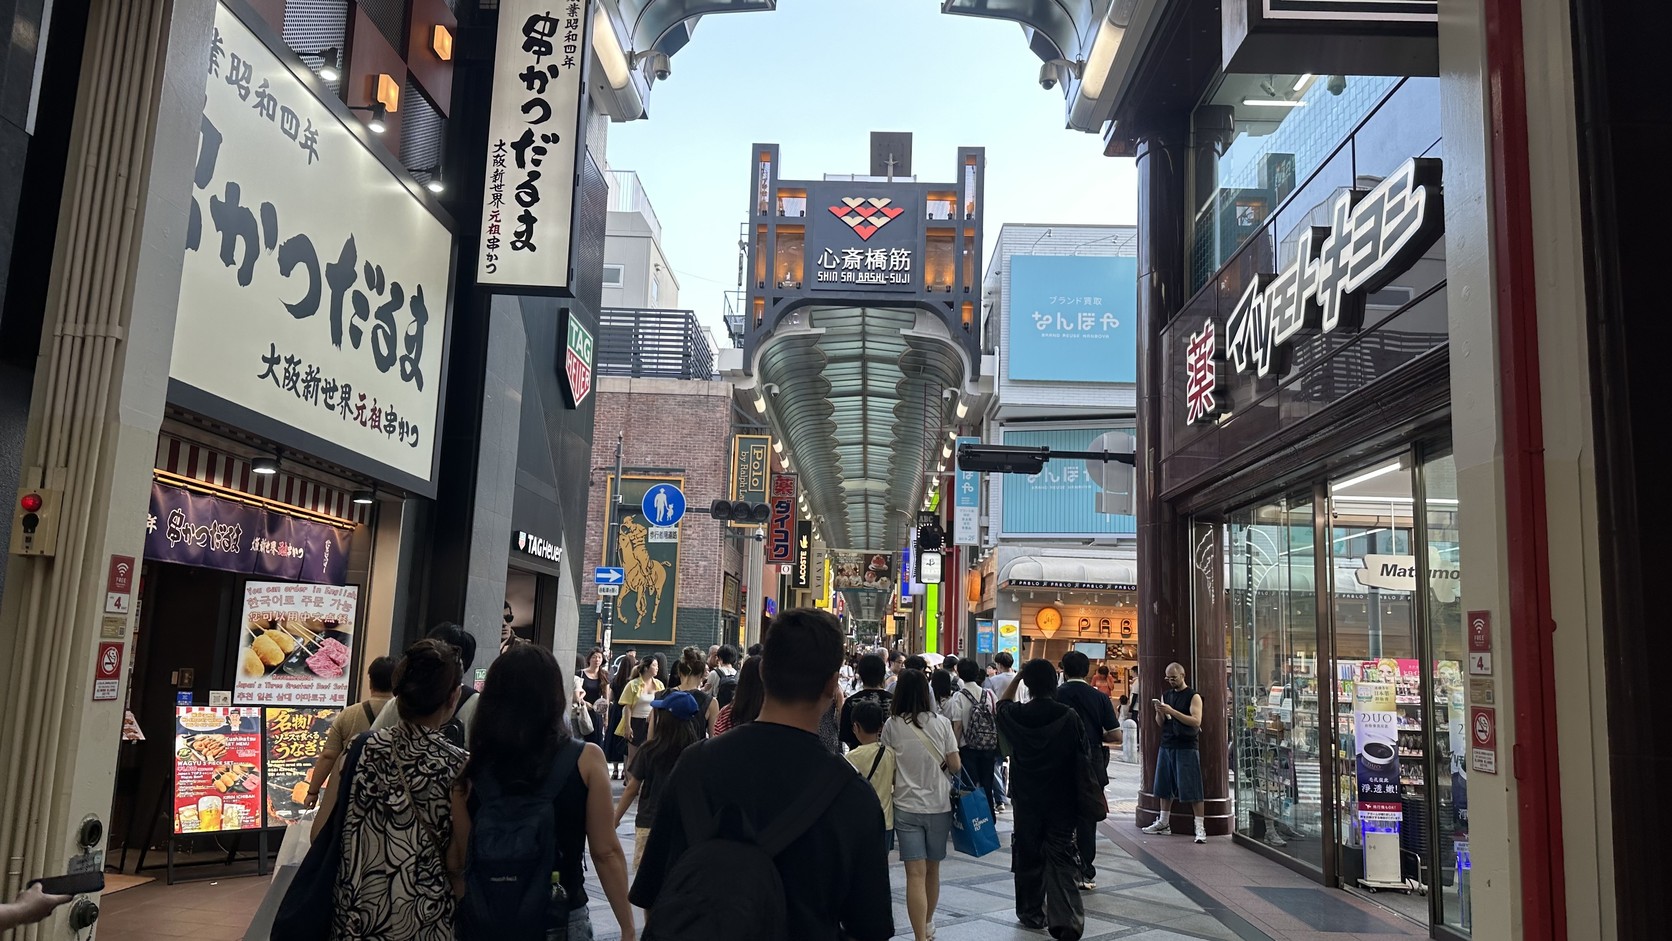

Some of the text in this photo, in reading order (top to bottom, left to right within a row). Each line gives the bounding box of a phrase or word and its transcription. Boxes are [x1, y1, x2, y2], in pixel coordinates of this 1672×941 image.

[561, 0, 581, 69] 業昭和四年
[509, 10, 561, 253] 串かつだるま
[484, 139, 508, 274] 大阪新世界元祖串かつ
[817, 247, 911, 271] 心斎橋筋
[1226, 157, 1426, 379] マツモトキヨシ
[817, 271, 838, 282] SHIN
[841, 271, 856, 282] SAI
[1049, 296, 1102, 306] ブランド買取
[1031, 311, 1119, 331] なんぼや
[570, 319, 591, 364] TAG
[567, 351, 590, 400] HEUER
[1187, 317, 1216, 425] 薬
[257, 343, 419, 448] 大阪新世界元祖串かつ
[739, 451, 749, 463] by
[752, 449, 763, 487] Polo
[739, 464, 749, 487] Ralph
[774, 474, 795, 496] 薬
[166, 508, 243, 553] 串かつだるま
[773, 500, 793, 558] ダイコク
[799, 551, 807, 585] LACOSTE
[284, 585, 308, 593] order
[113, 597, 122, 609] 4
[247, 595, 352, 613] 한국어로 주문 가능
[1476, 656, 1484, 670] 4
[1361, 713, 1392, 723] DUO
[274, 731, 320, 744] ソースで食べる
[275, 740, 317, 760] うなぎ
